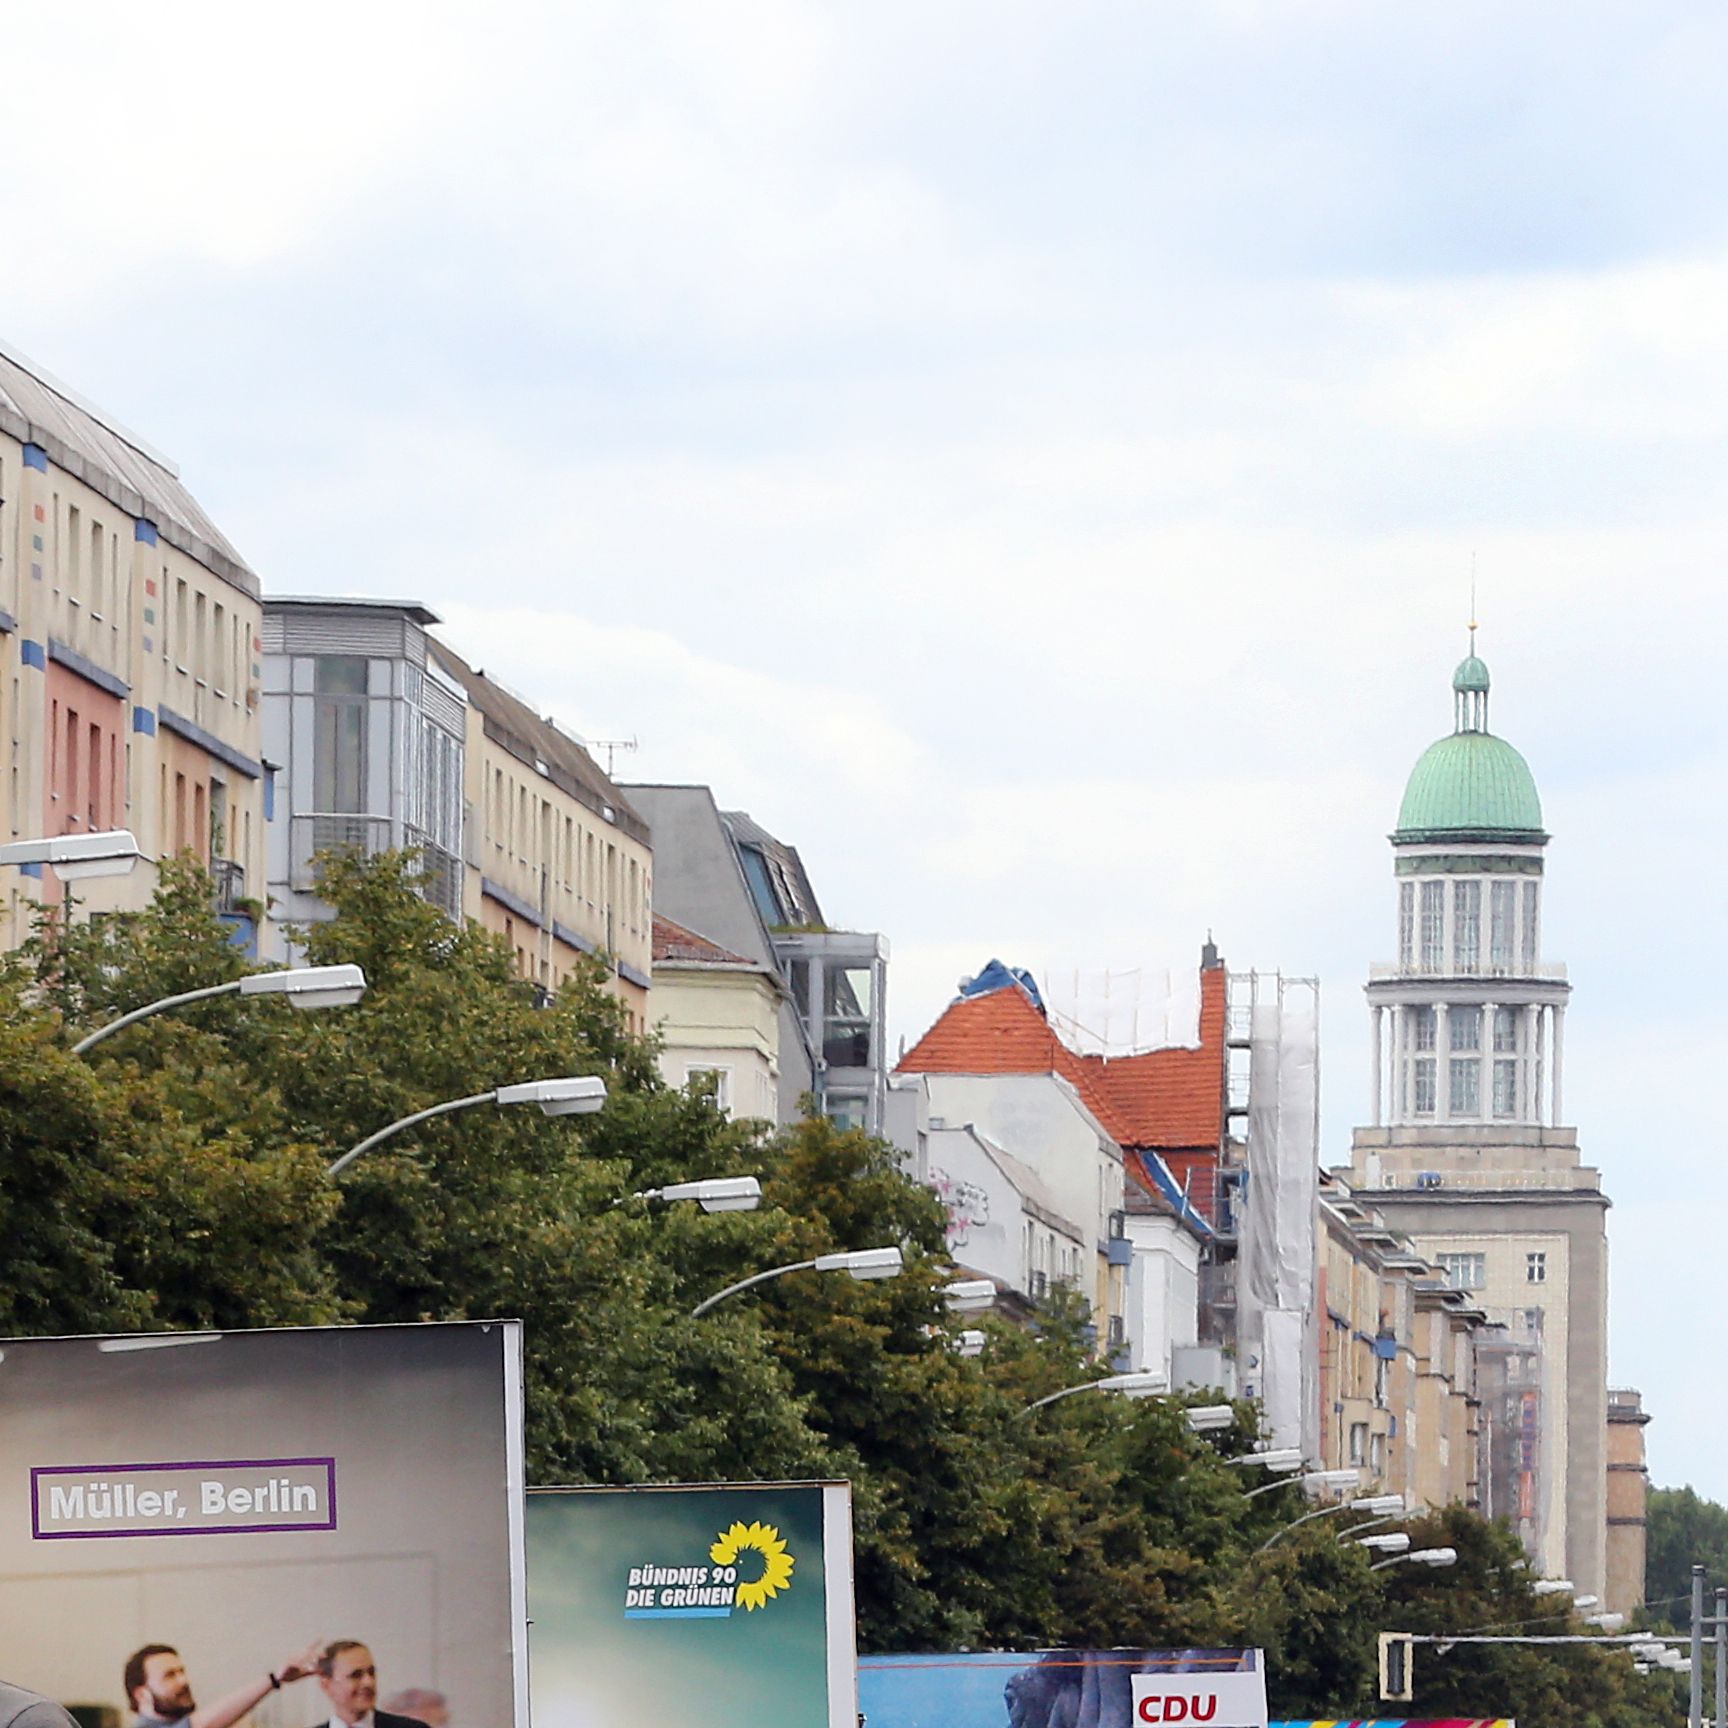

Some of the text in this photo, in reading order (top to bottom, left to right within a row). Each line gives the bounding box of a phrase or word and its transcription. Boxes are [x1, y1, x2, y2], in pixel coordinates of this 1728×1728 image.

[50, 1479, 317, 1519] Müller, Berlin
[629, 1564, 736, 1586] BÜNDNIS 90
[626, 1585, 734, 1607] DIE GRÜNEN
[1138, 1695, 1216, 1723] CDU
